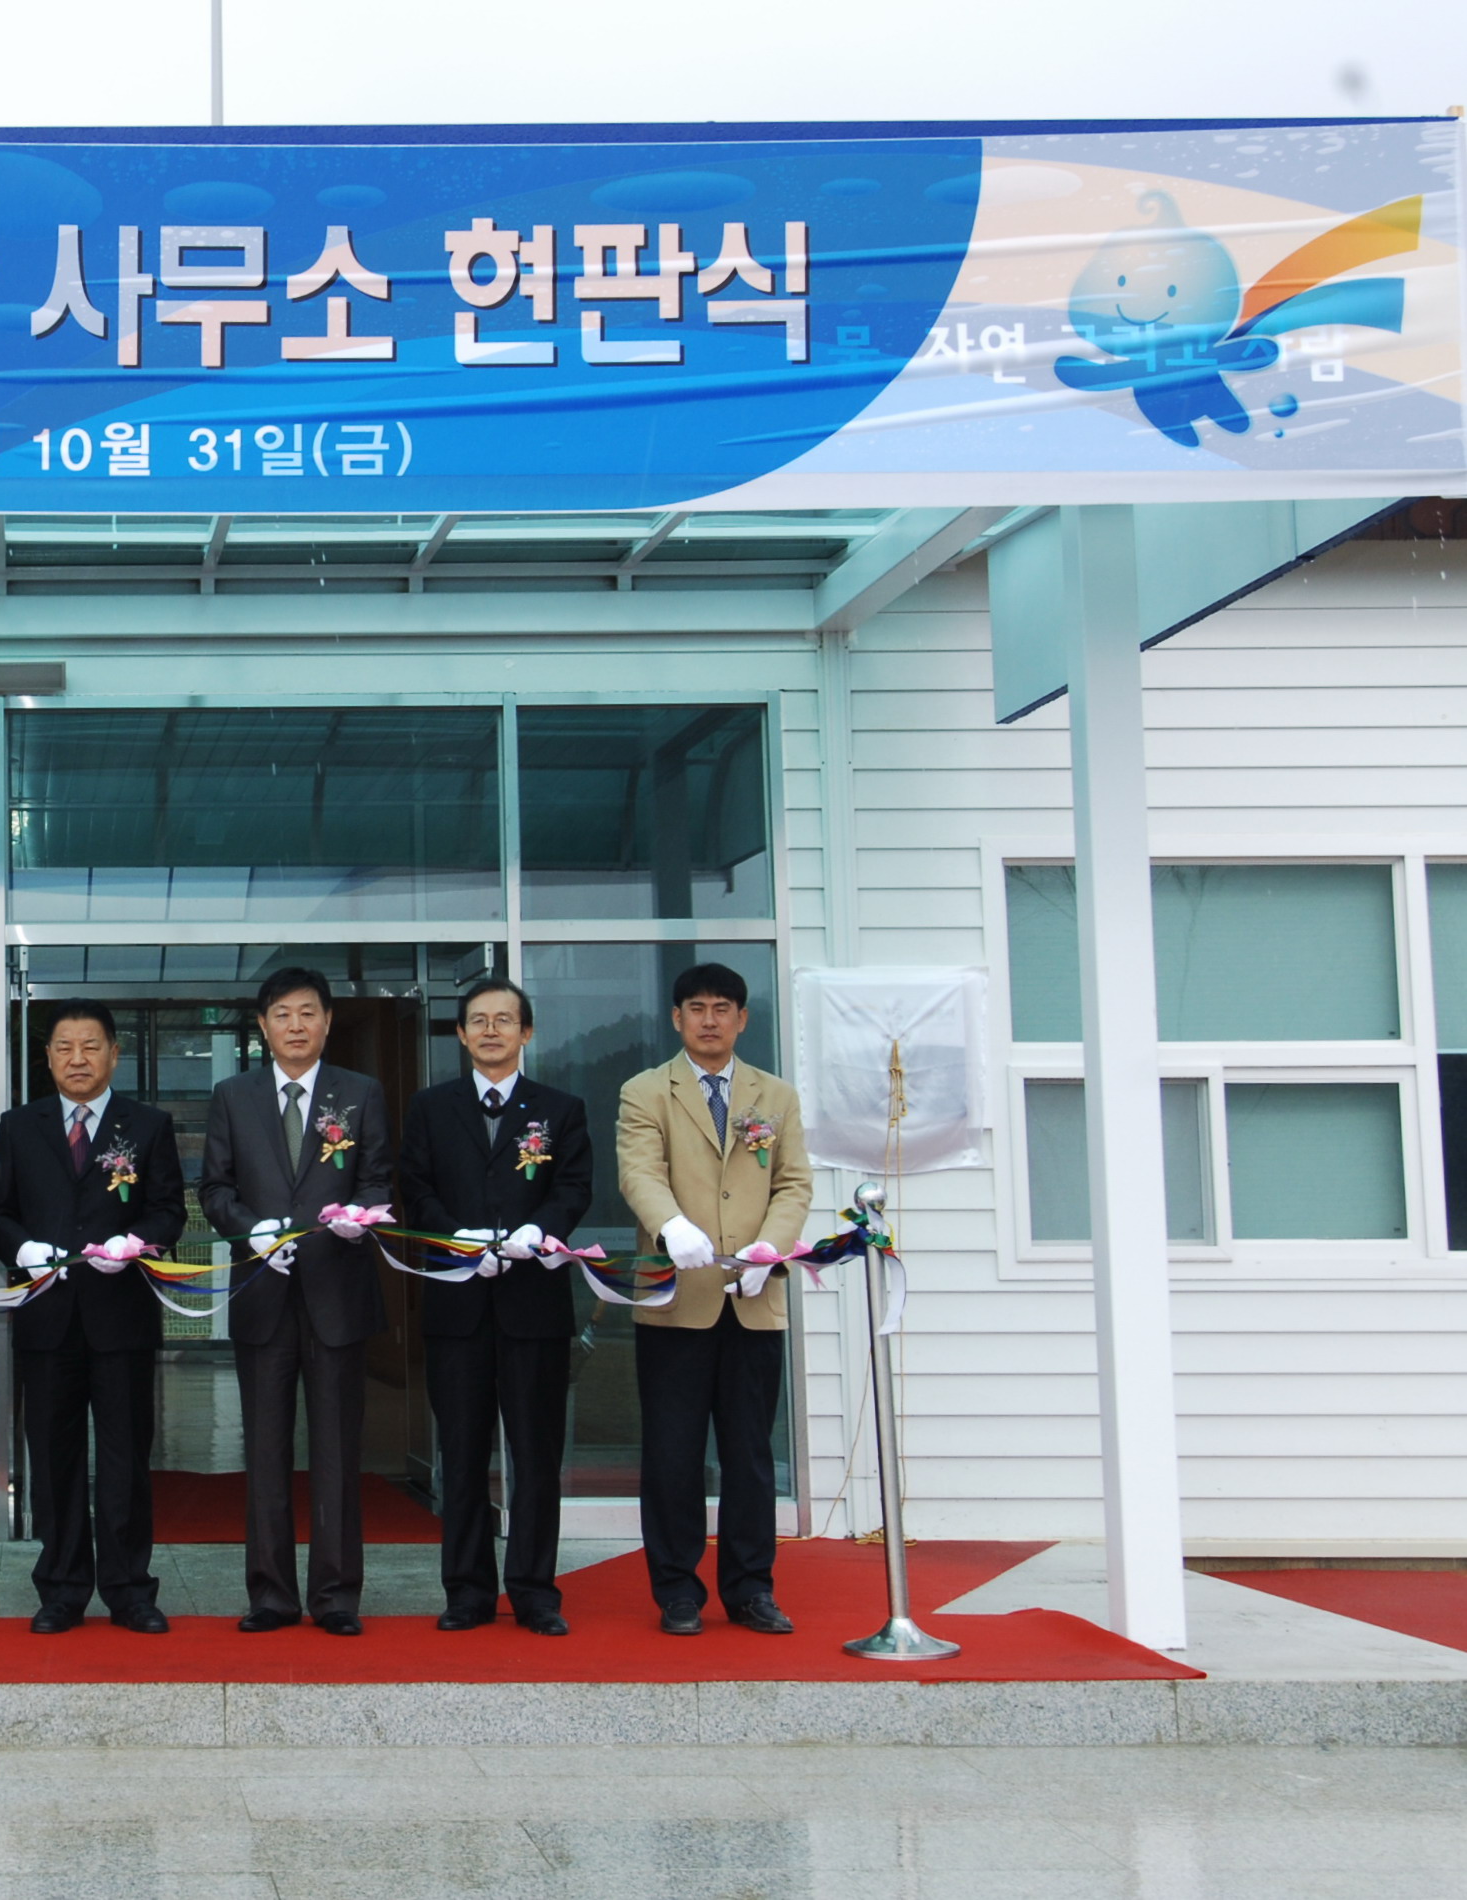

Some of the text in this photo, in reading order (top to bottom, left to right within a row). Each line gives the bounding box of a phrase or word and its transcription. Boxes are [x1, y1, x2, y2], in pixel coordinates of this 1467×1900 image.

[31, 224, 396, 369] 사무소
[444, 216, 810, 367] 현판식
[32, 421, 153, 478] 10월
[187, 421, 413, 478] 31일(금)
